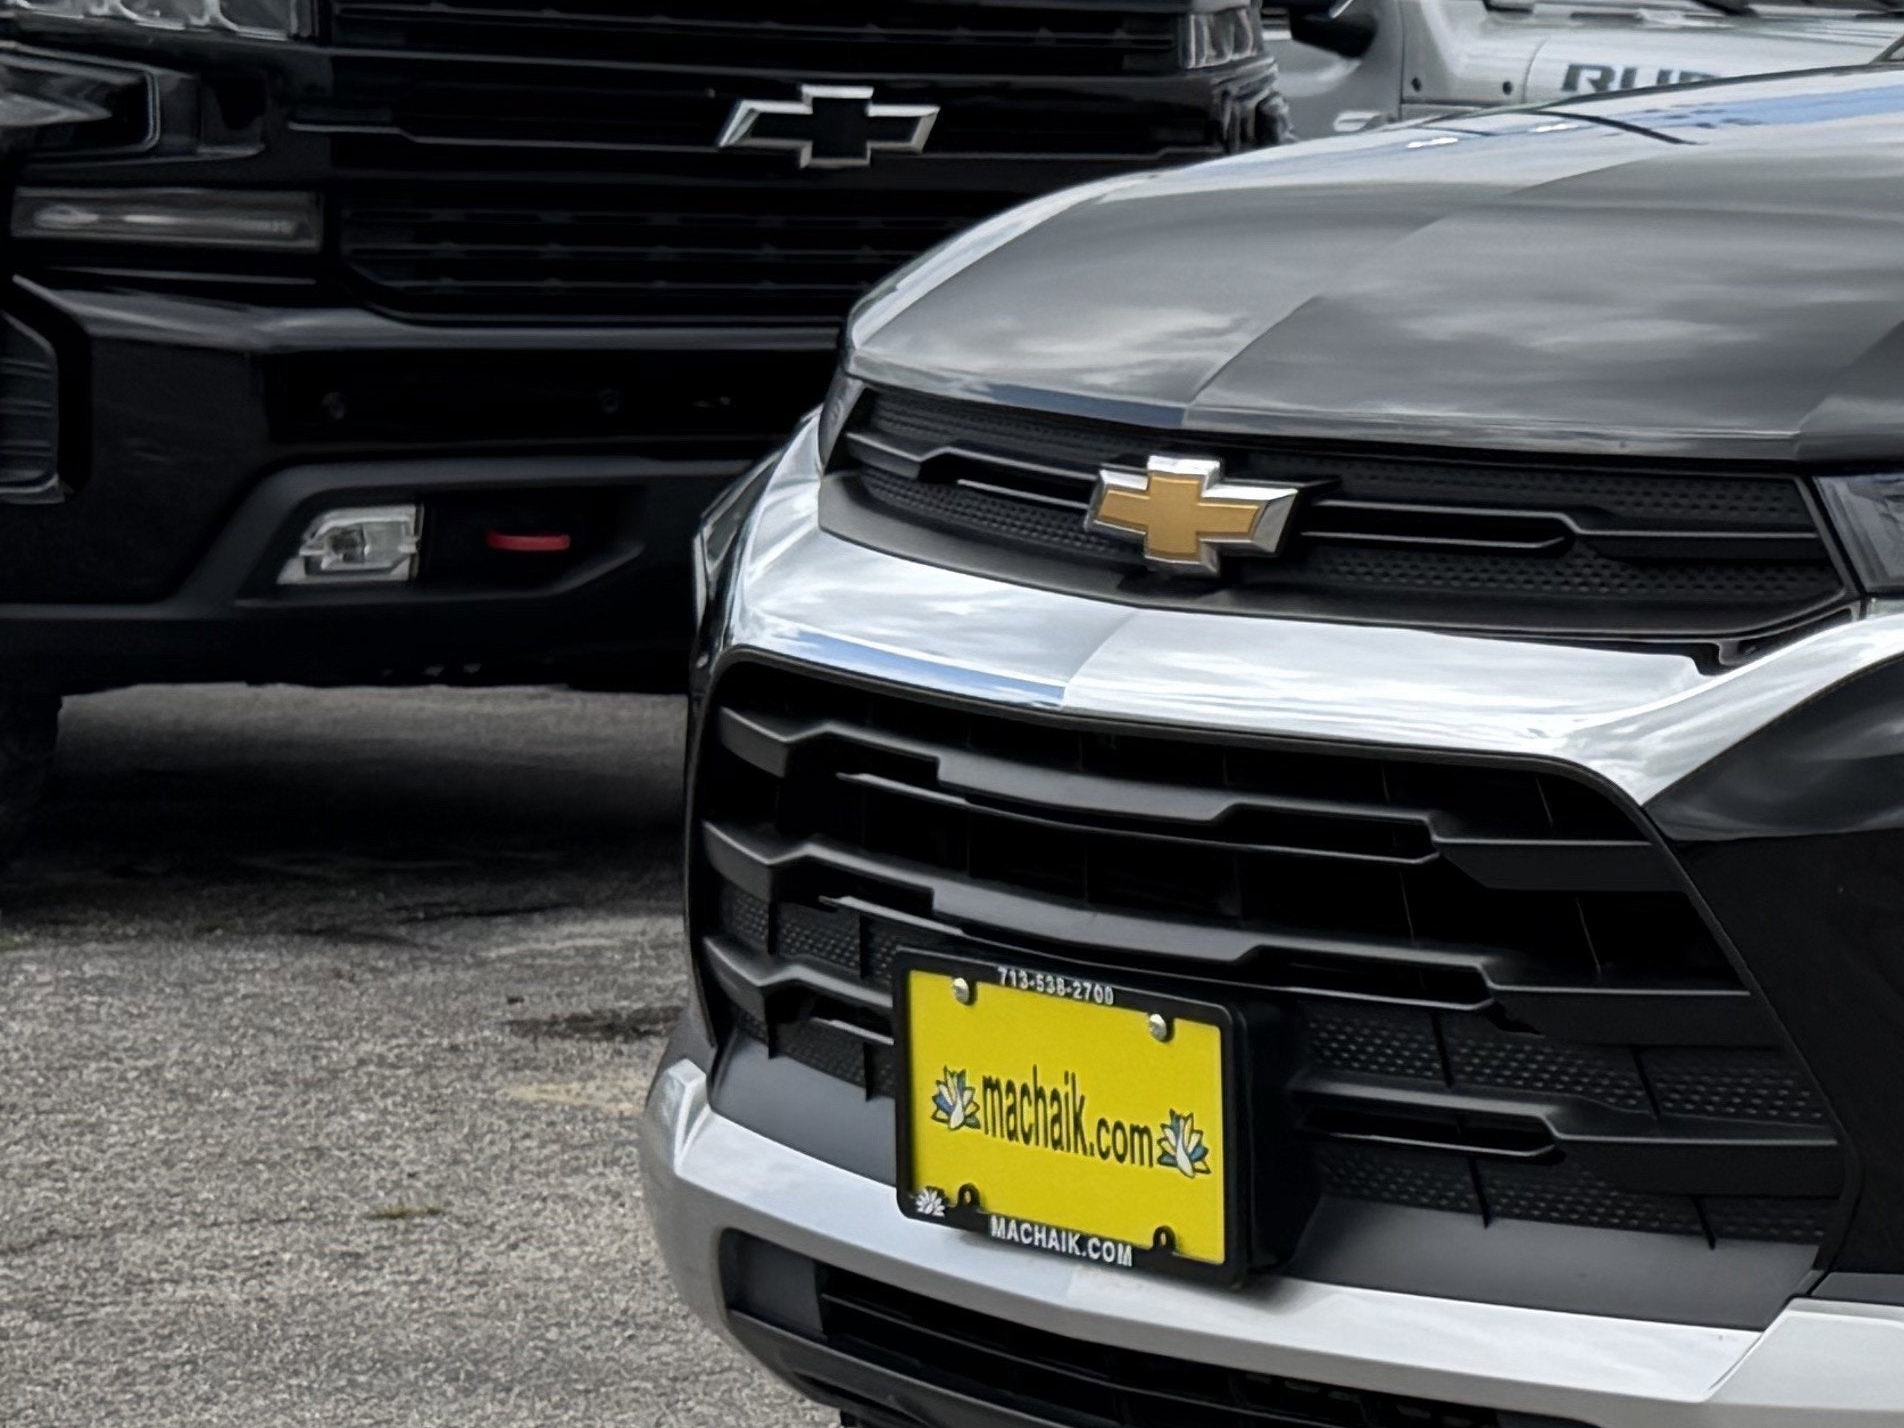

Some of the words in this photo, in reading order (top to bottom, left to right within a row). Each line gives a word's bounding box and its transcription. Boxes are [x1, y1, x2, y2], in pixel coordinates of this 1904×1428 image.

[998, 967, 1114, 1005] 713-538-2700
[982, 1064, 1154, 1168] machaik.com
[990, 1215, 1133, 1268] MACHAIK.COM
